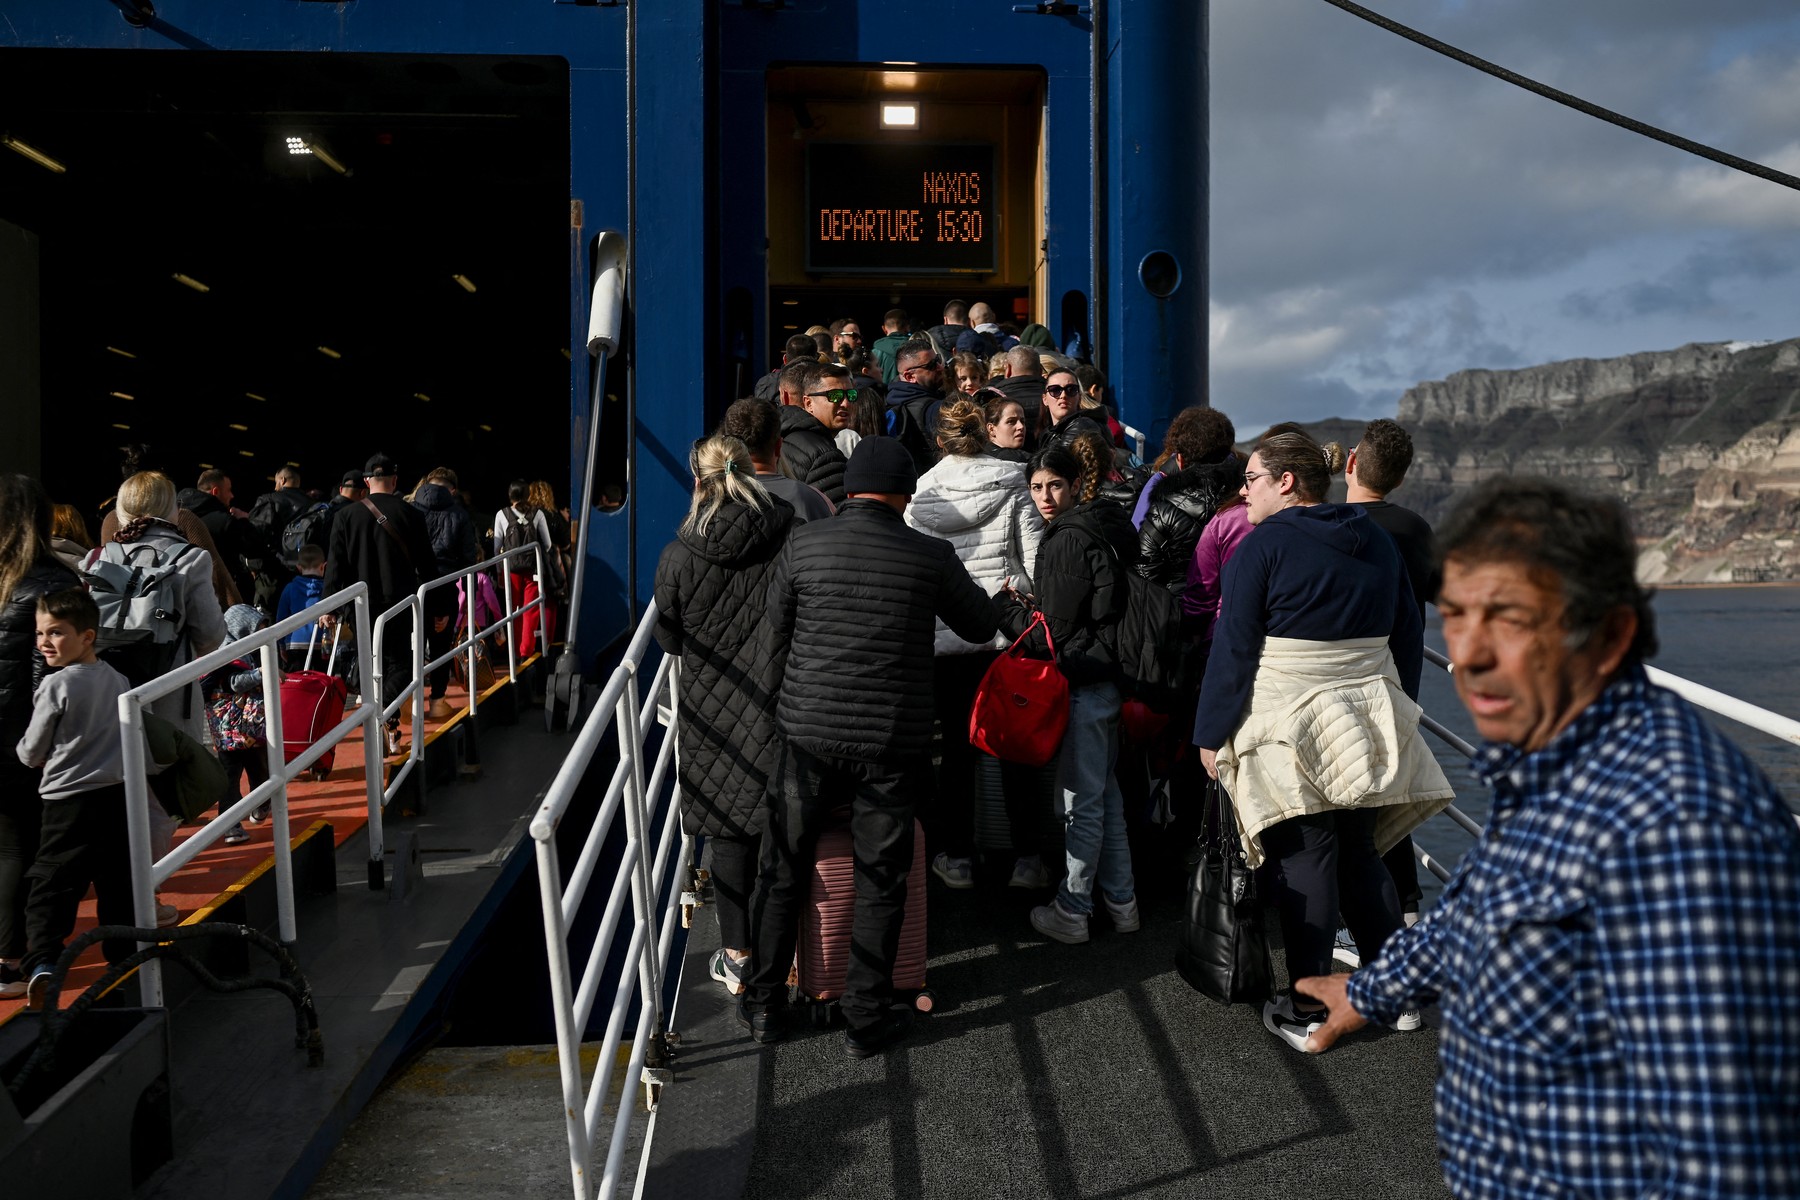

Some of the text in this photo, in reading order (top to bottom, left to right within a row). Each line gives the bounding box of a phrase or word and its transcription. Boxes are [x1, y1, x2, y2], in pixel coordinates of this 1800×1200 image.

[923, 172, 980, 203] NAXOS
[821, 209, 982, 241] DEPARTURE: 15:30
